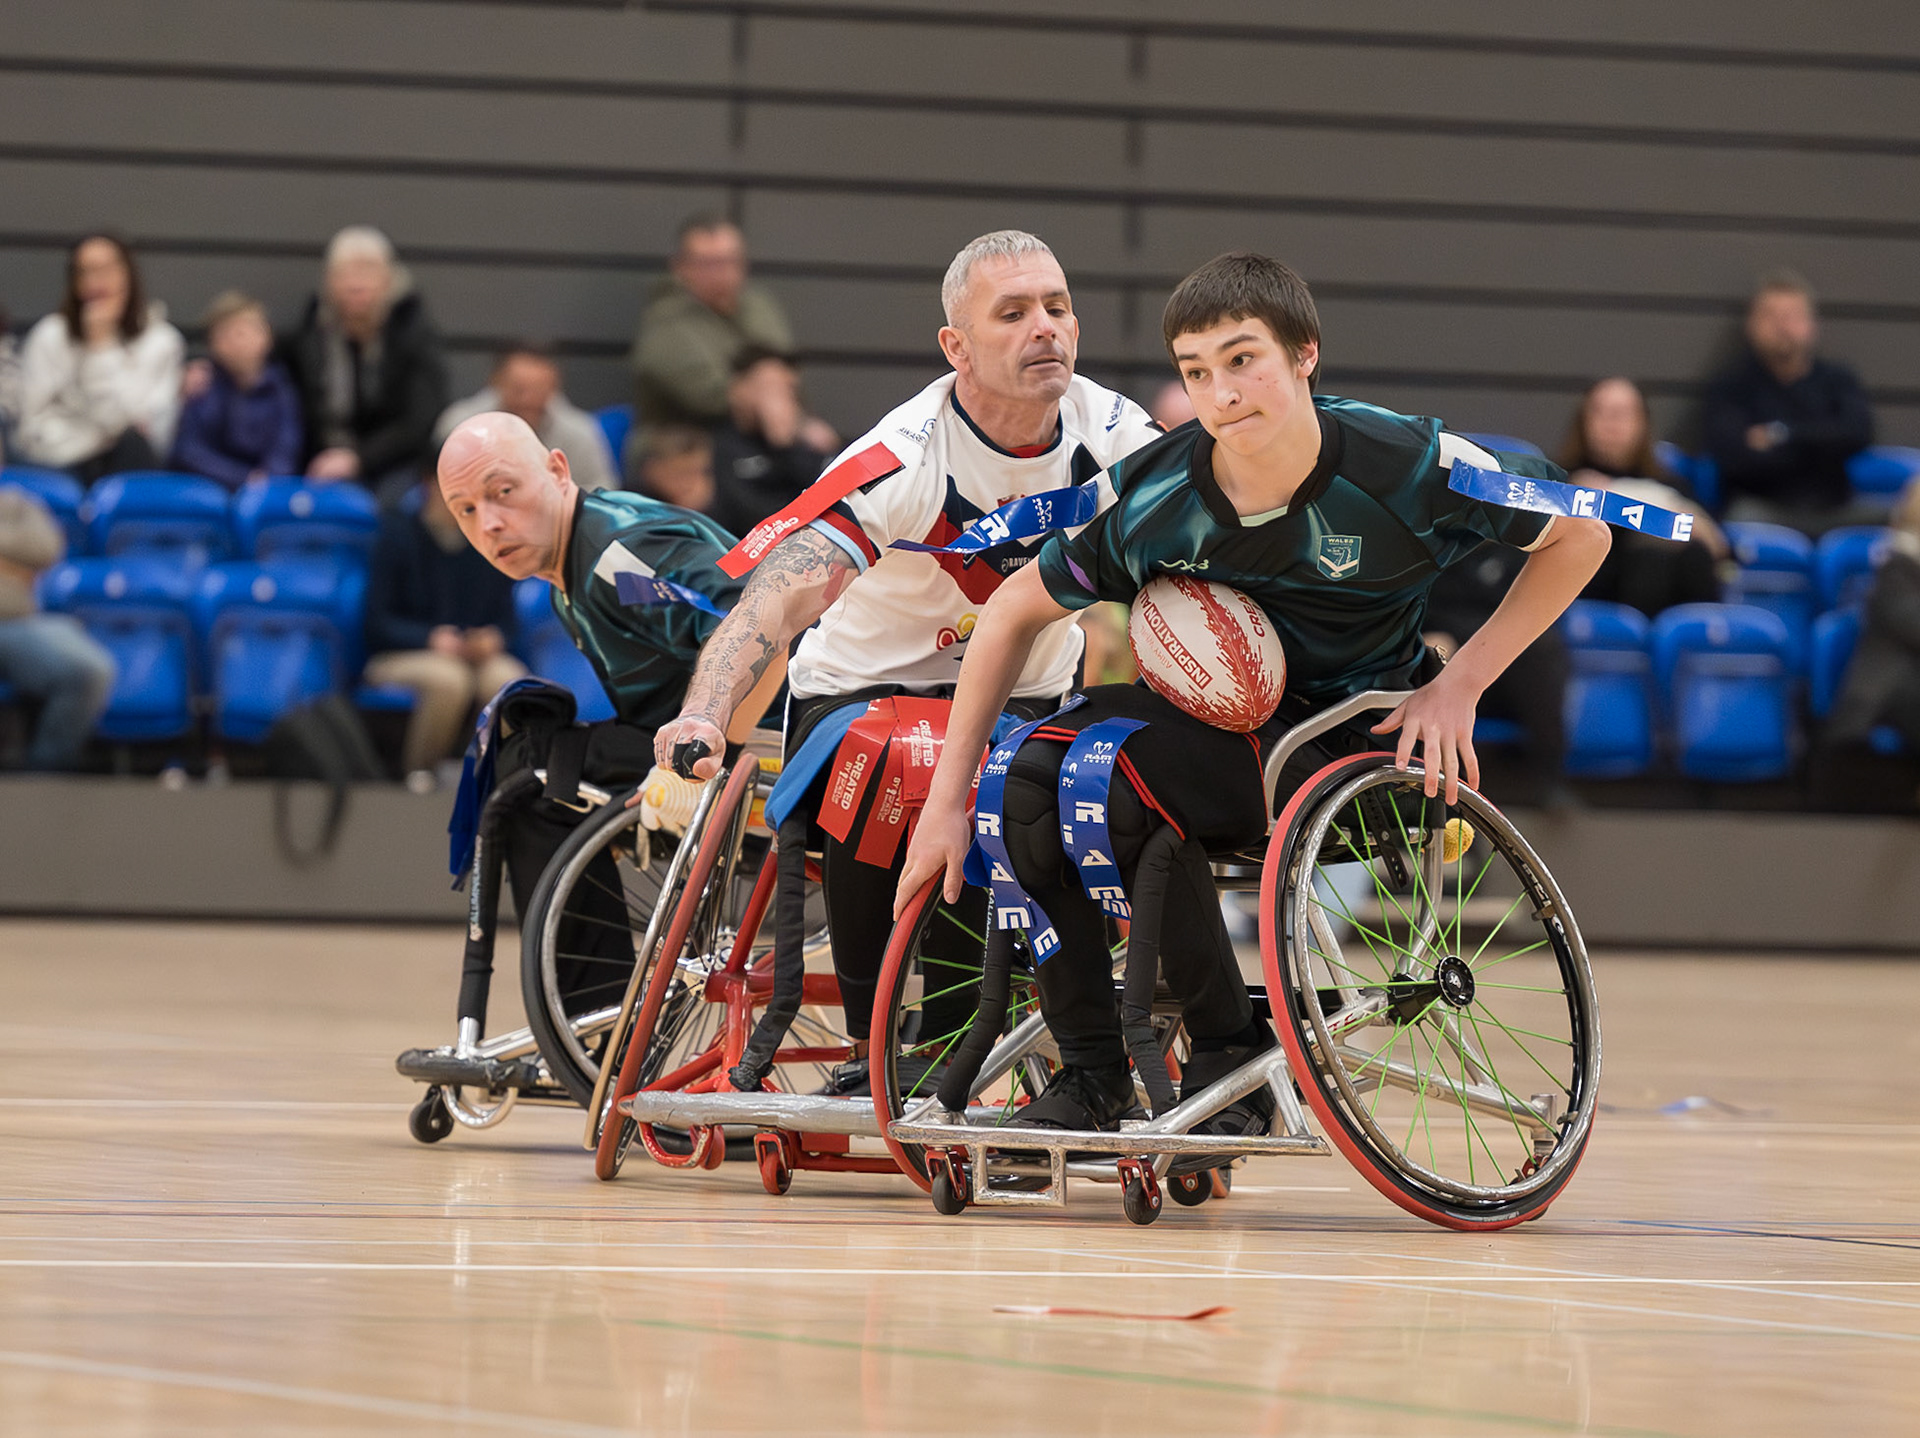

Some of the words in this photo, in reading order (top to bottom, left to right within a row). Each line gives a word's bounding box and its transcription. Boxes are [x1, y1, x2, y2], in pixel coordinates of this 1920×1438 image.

[749, 516, 799, 559] CREATED
[919, 719, 934, 768] CREATED
[840, 752, 868, 811] CREATED
